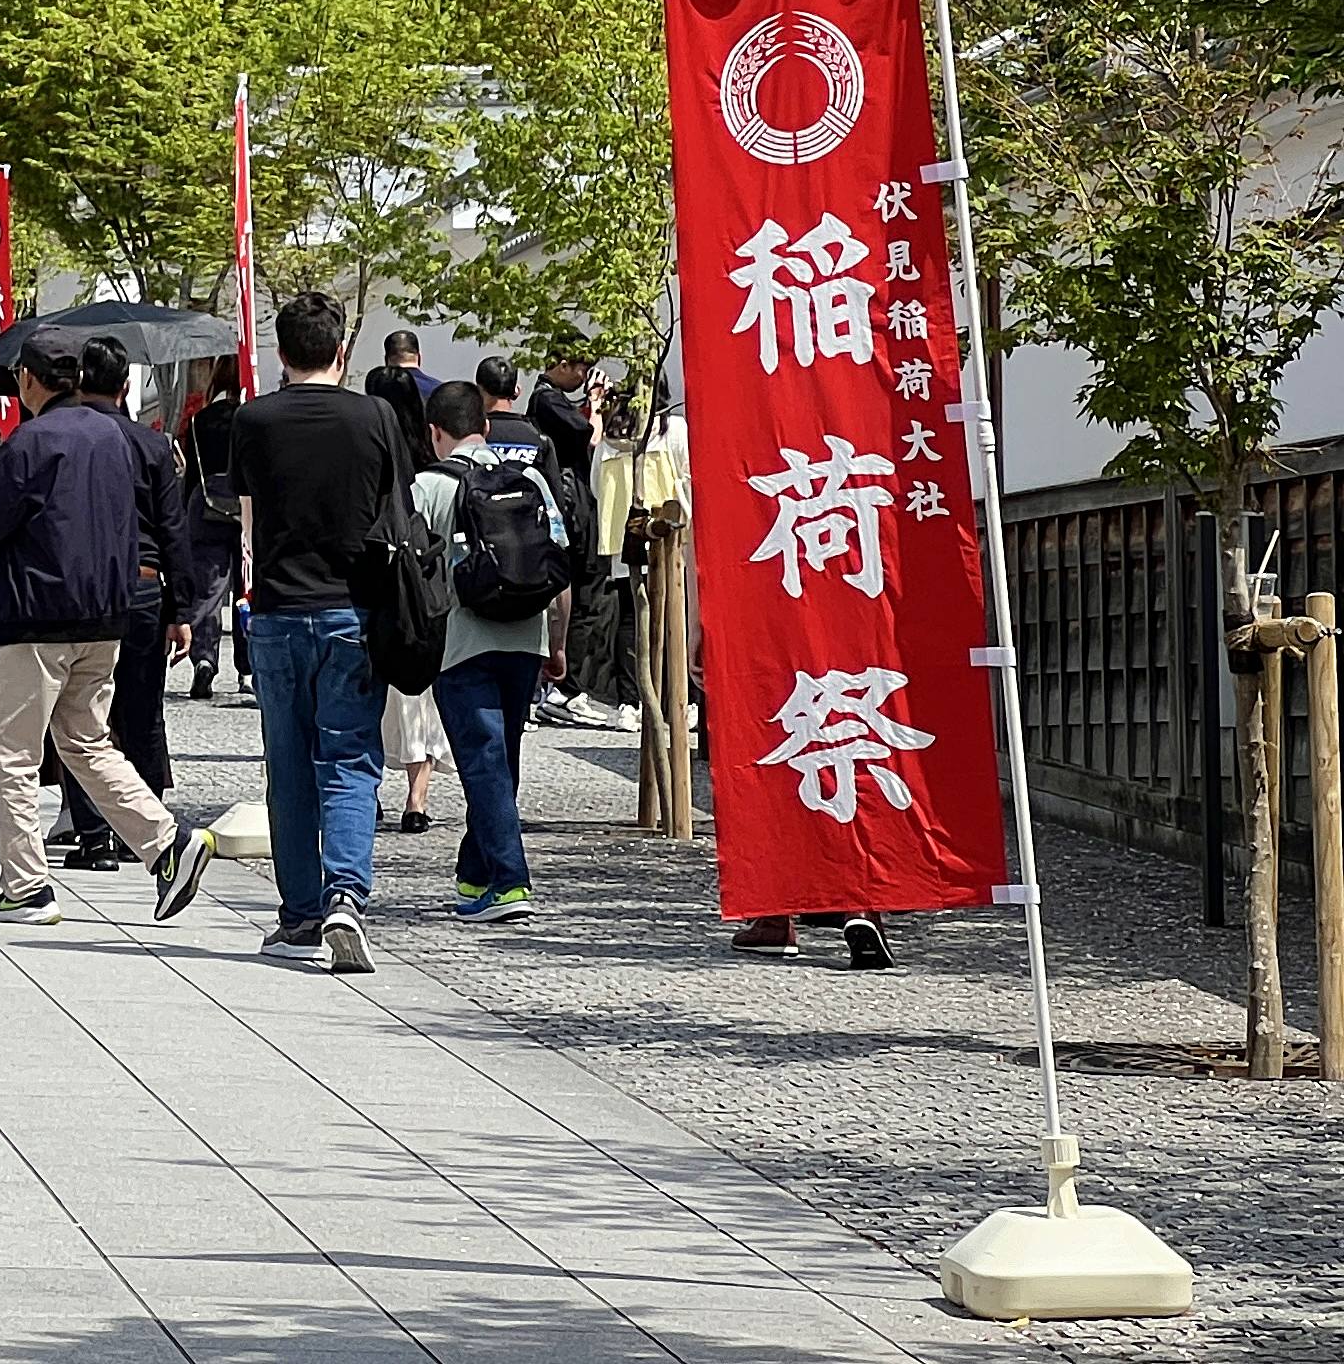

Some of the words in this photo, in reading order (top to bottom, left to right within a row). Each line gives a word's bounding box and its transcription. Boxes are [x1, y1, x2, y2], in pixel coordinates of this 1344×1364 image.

[728, 211, 937, 825] 稲荷祭
[871, 181, 951, 523] 伏見稲荷大社
